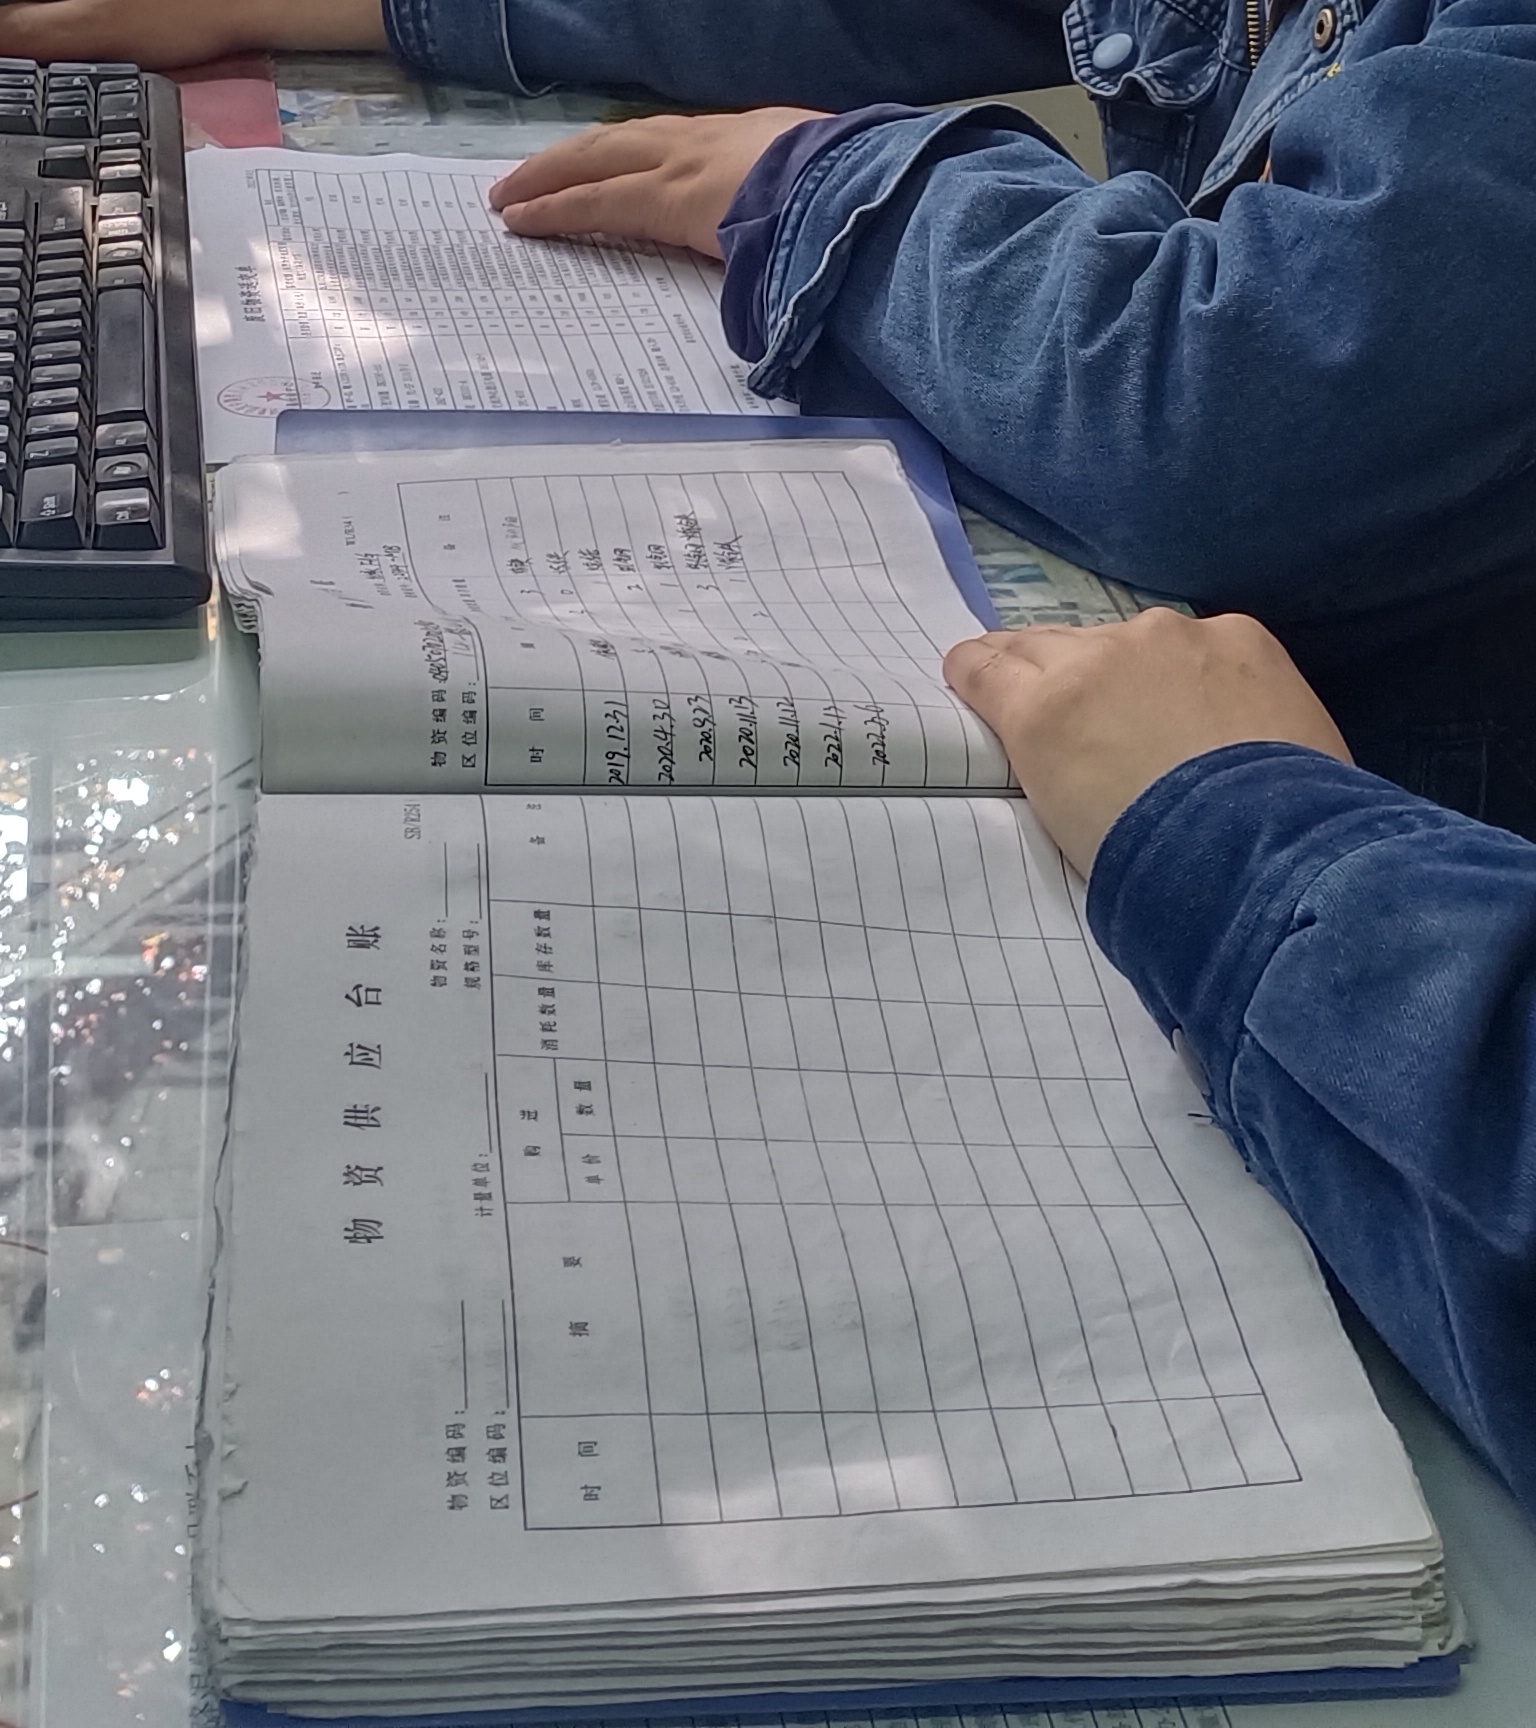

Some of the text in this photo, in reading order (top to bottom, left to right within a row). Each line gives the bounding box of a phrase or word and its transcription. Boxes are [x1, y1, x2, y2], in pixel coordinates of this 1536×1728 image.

[534, 908, 553, 974] 库存数量
[538, 985, 560, 1052] 消耗数量
[343, 924, 384, 1245] 物资供应台账
[561, 1255, 591, 1339] 摘要
[445, 1408, 470, 1511] 物资编码：
[485, 1408, 511, 1511] 区位编码：
[577, 1440, 603, 1503] 时间
